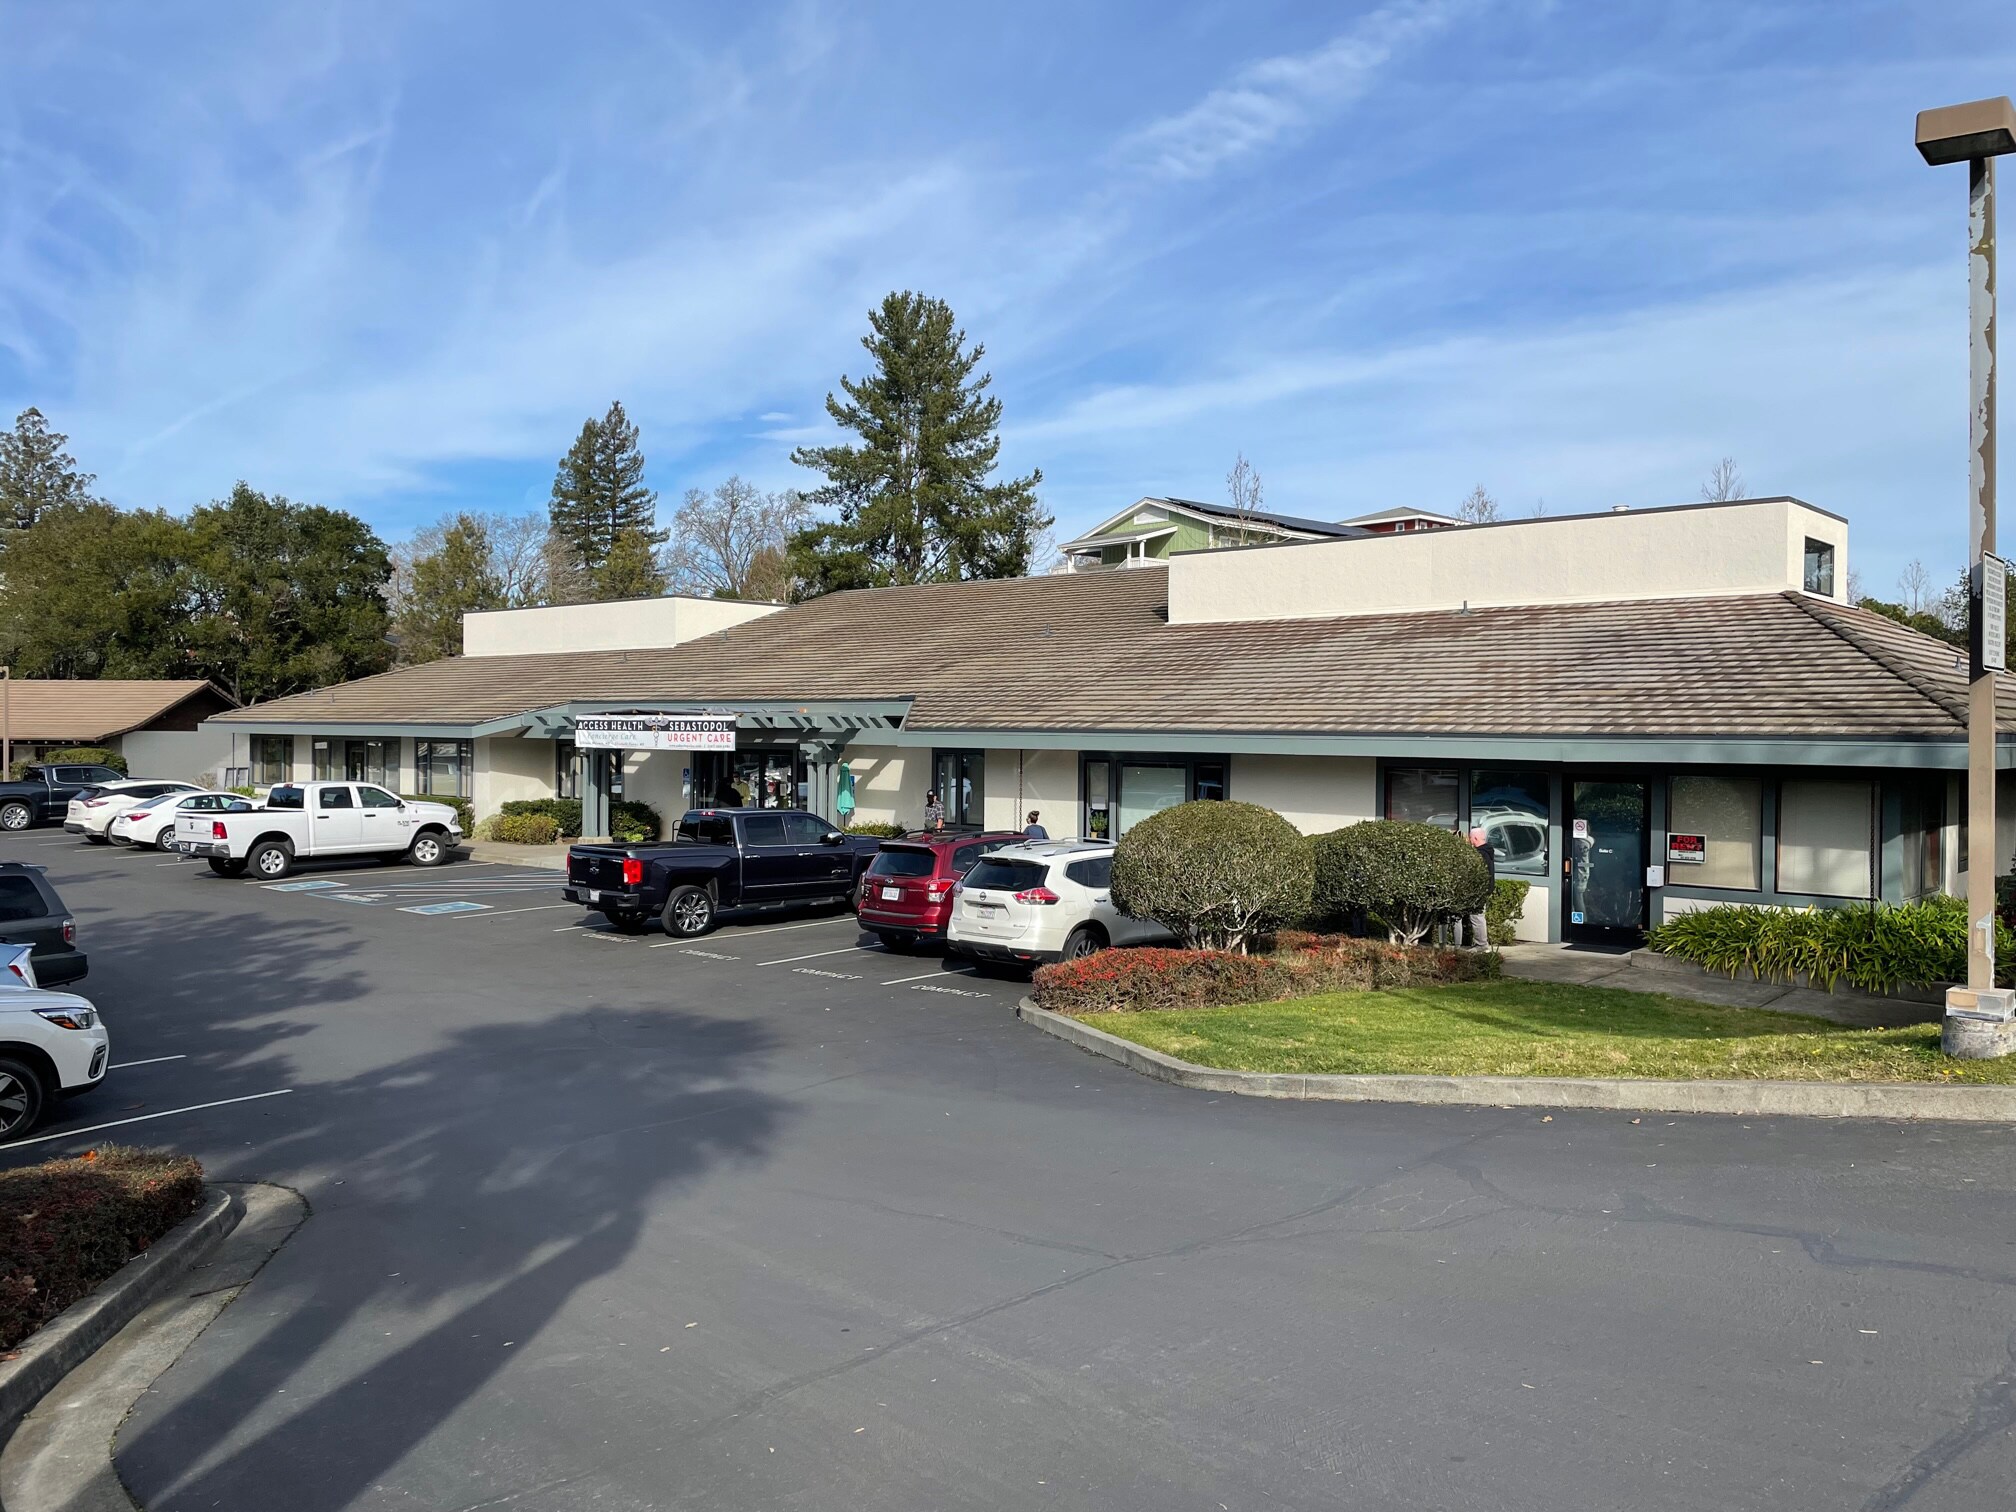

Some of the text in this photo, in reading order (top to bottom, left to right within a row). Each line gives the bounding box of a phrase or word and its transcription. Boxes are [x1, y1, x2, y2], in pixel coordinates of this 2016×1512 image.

[577, 720, 643, 730] ACCESS HEALTH
[669, 721, 729, 731] SEBASTOPOL
[667, 733, 732, 743] URGENT CARE
[1677, 835, 1697, 843] FOR
[1671, 842, 1703, 851] RENT
[792, 967, 864, 980] COMPACT
[910, 984, 992, 998] COMPACT
